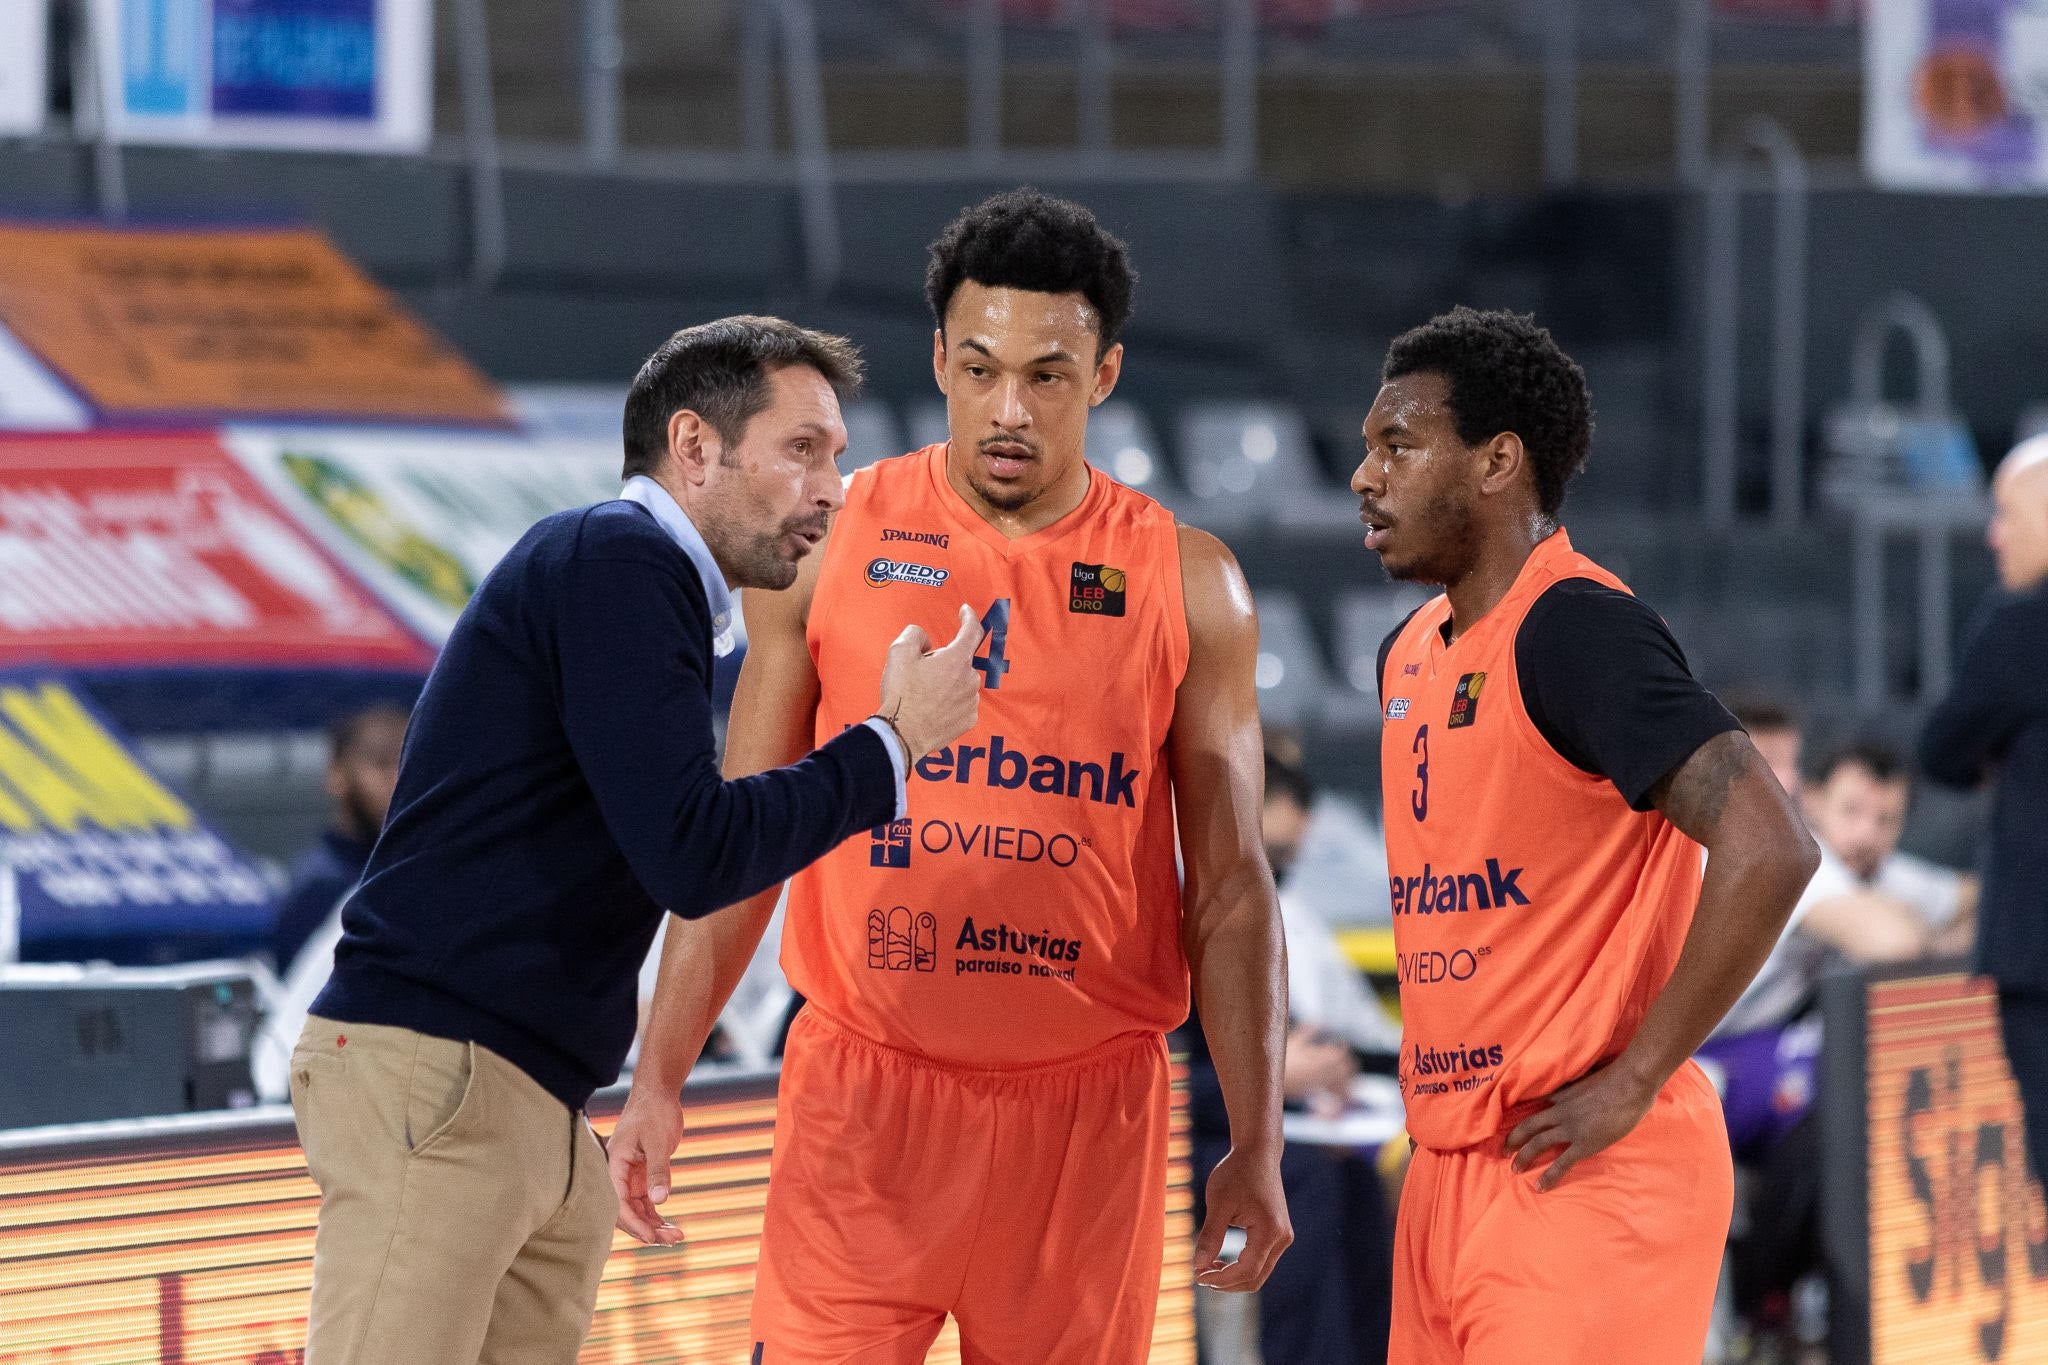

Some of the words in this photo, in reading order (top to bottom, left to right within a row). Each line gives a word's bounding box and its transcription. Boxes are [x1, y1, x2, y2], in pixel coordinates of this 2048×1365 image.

[880, 528, 950, 550] SPALDING
[873, 561, 949, 581] OVIEDO
[887, 573, 945, 588] BALONCESTO
[1073, 567, 1095, 582] Liga
[1073, 584, 1105, 600] LEB
[1072, 599, 1103, 612] ORO
[972, 597, 1011, 690] 4
[1452, 698, 1468, 713] LEB
[1450, 713, 1465, 725] ORO
[915, 735, 1141, 809] erbank
[1411, 723, 1429, 823] 3
[1390, 858, 1531, 915] erbank
[955, 915, 1083, 962] Asturias
[955, 957, 1023, 977] paraíso
[1412, 1042, 1504, 1076] Asturias
